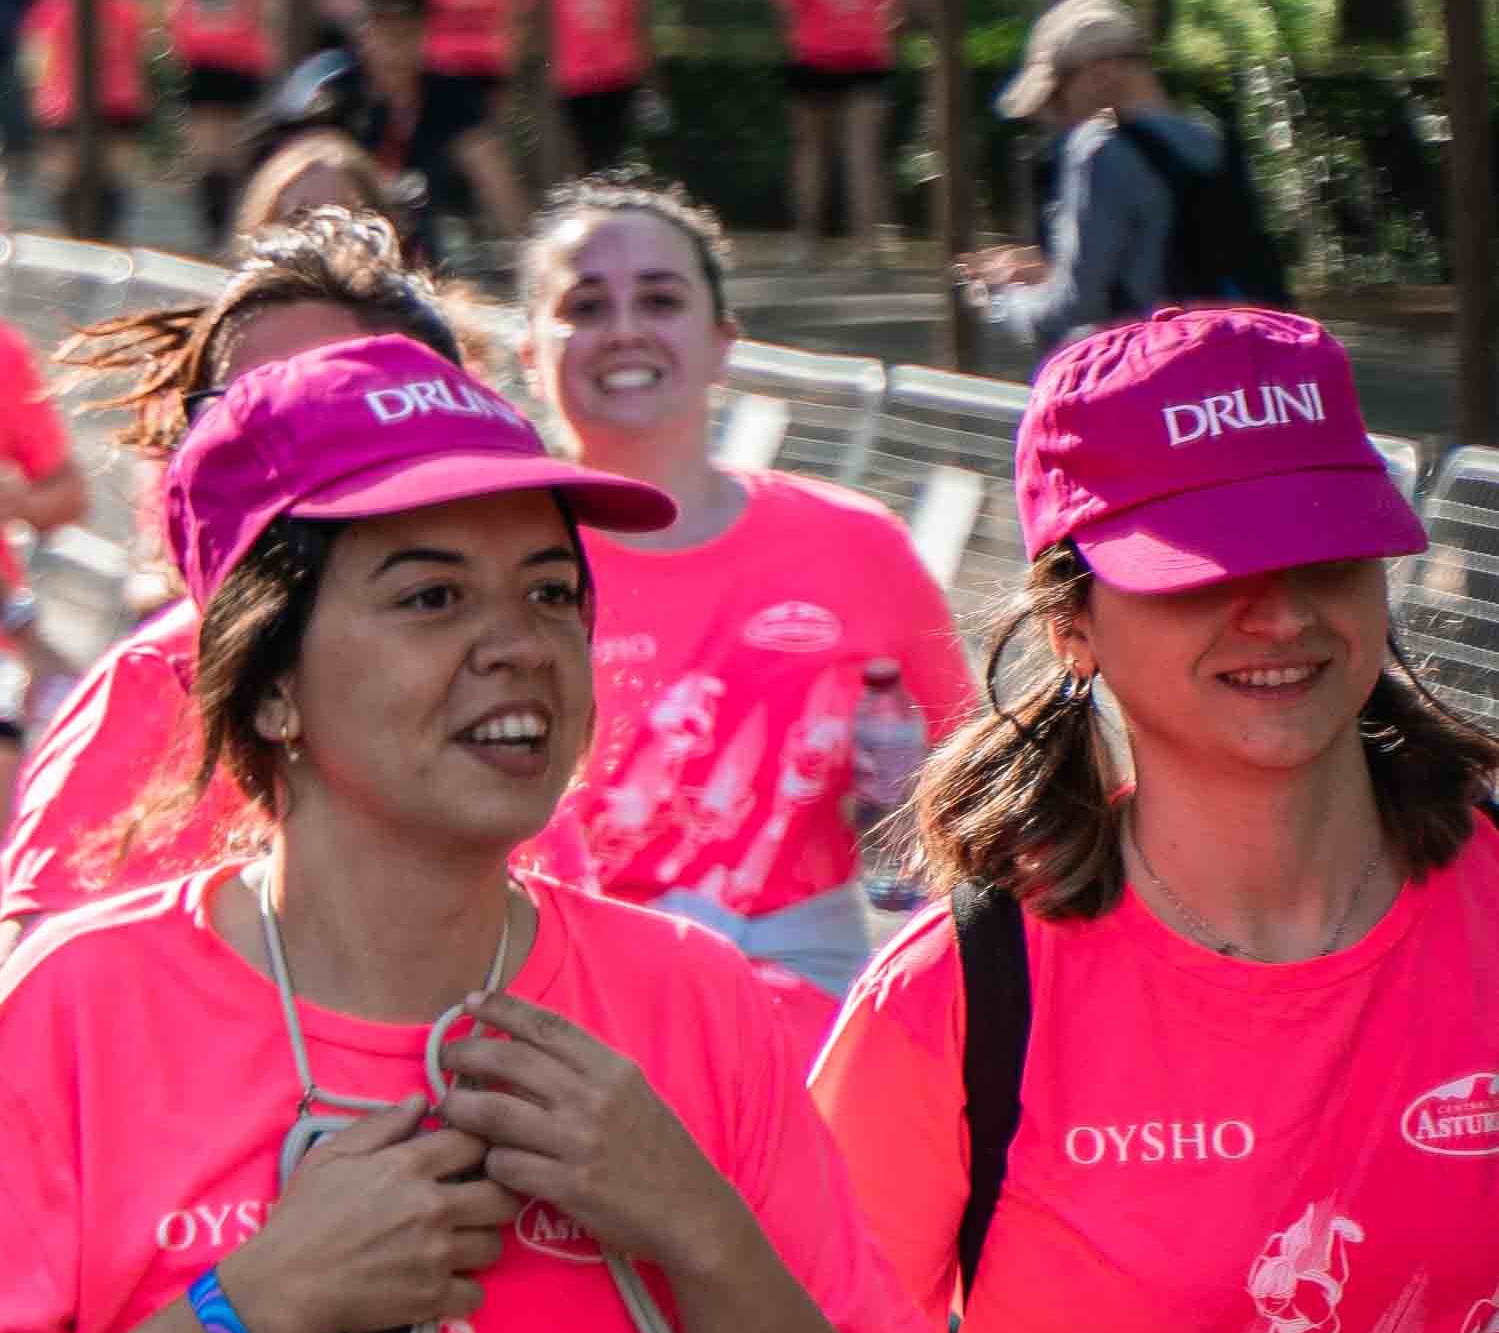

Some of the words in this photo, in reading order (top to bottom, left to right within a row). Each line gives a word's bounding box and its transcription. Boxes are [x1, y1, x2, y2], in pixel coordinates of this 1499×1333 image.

[1161, 381, 1327, 446] DRUNI
[1065, 1120, 1255, 1166] OYSHO
[1415, 1110, 1499, 1139] ASTUR
[157, 1201, 262, 1252] OYS
